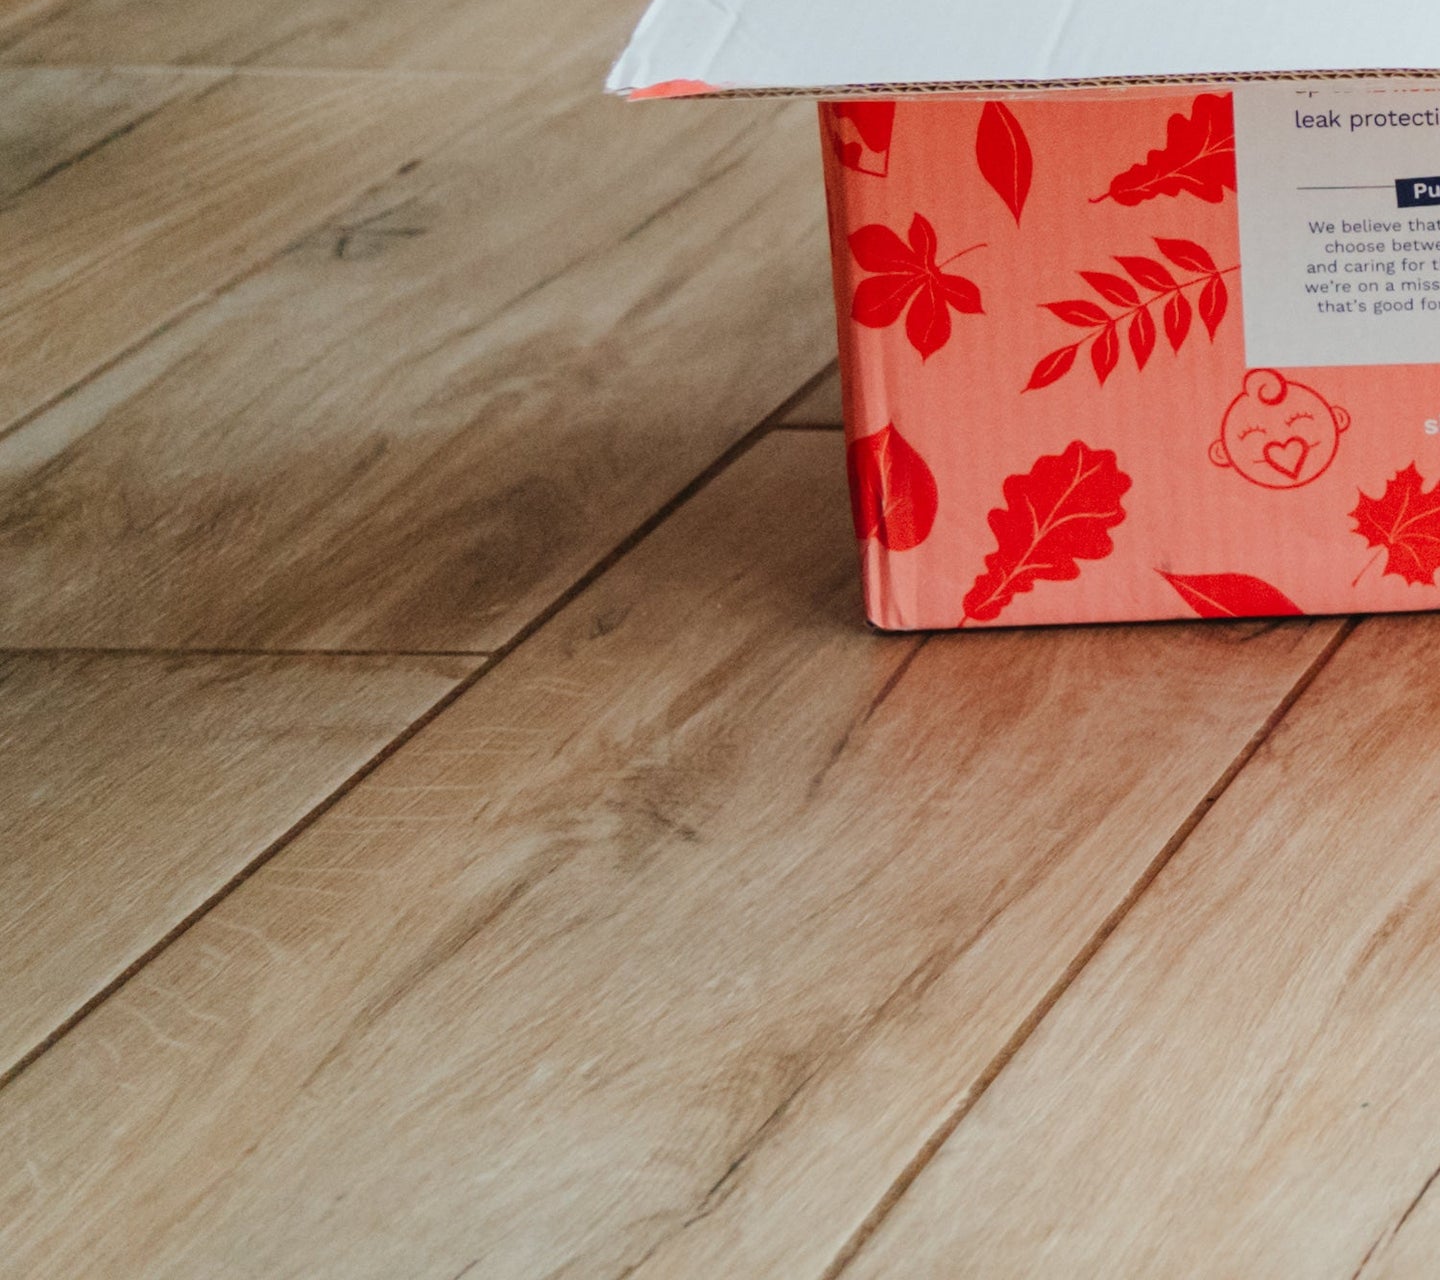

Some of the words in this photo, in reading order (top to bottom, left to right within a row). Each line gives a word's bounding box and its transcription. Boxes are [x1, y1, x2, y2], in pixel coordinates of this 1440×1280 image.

[1295, 109, 1341, 128] leak
[1308, 221, 1335, 234] We
[1341, 219, 1402, 233] believe
[1324, 239, 1385, 253] choose
[1306, 259, 1337, 274] and
[1343, 261, 1395, 276] caring
[1401, 257, 1425, 271] for
[1304, 279, 1351, 294] we're
[1357, 282, 1379, 292] on
[1385, 281, 1395, 292] a
[1317, 299, 1367, 313] that's
[1373, 297, 1414, 315] good
